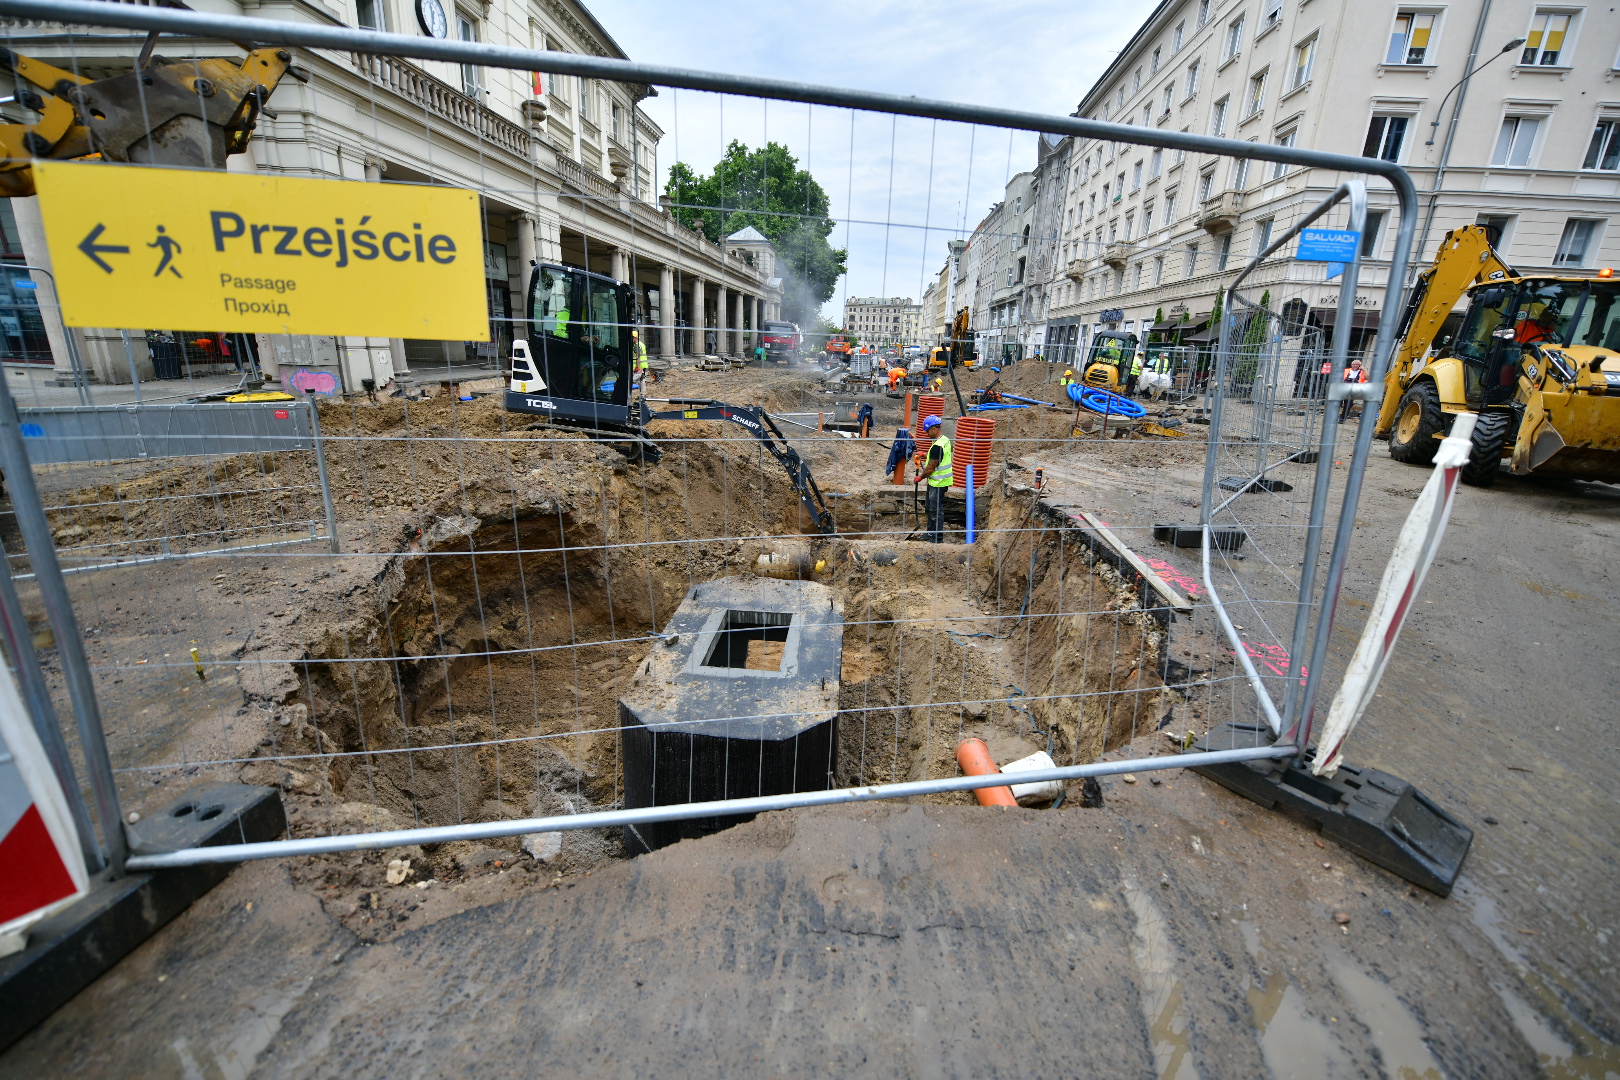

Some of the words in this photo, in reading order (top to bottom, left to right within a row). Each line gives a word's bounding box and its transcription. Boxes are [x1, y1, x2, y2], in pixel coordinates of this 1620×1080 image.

[210, 210, 456, 268] Przejście
[1304, 232, 1356, 244] SALVADA
[220, 273, 297, 293] Passage
[224, 297, 290, 317] Прохід
[731, 414, 760, 430] SCHAEFF
